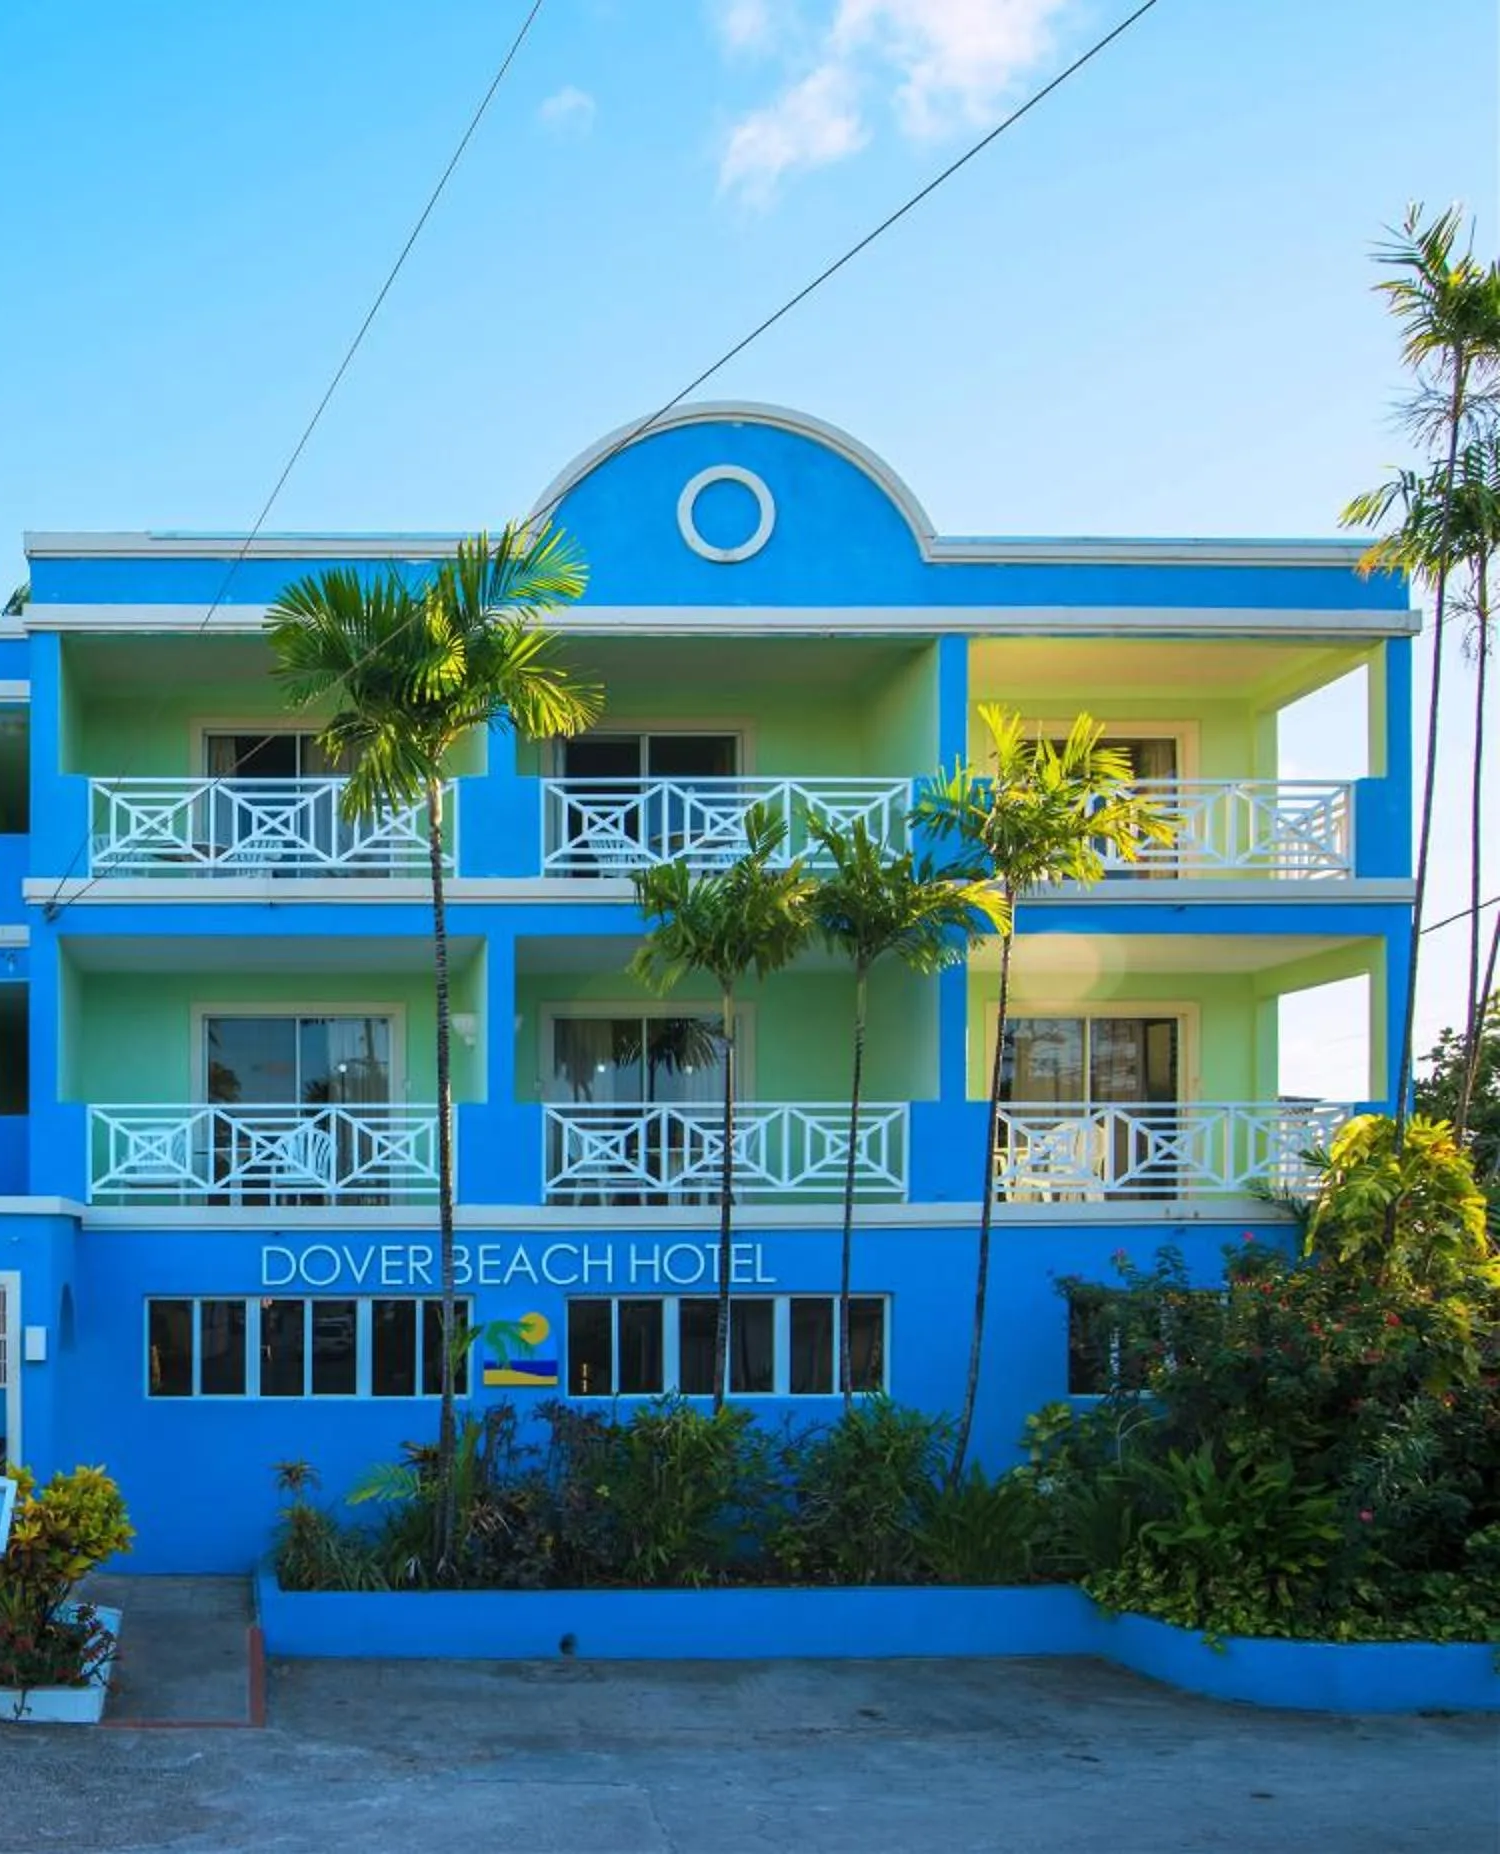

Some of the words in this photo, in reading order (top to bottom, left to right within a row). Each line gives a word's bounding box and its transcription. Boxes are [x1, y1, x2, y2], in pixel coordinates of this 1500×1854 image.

[262, 1245, 433, 1286] DOVER
[450, 1243, 613, 1285] BEACH
[629, 1243, 778, 1284] HOTEL
